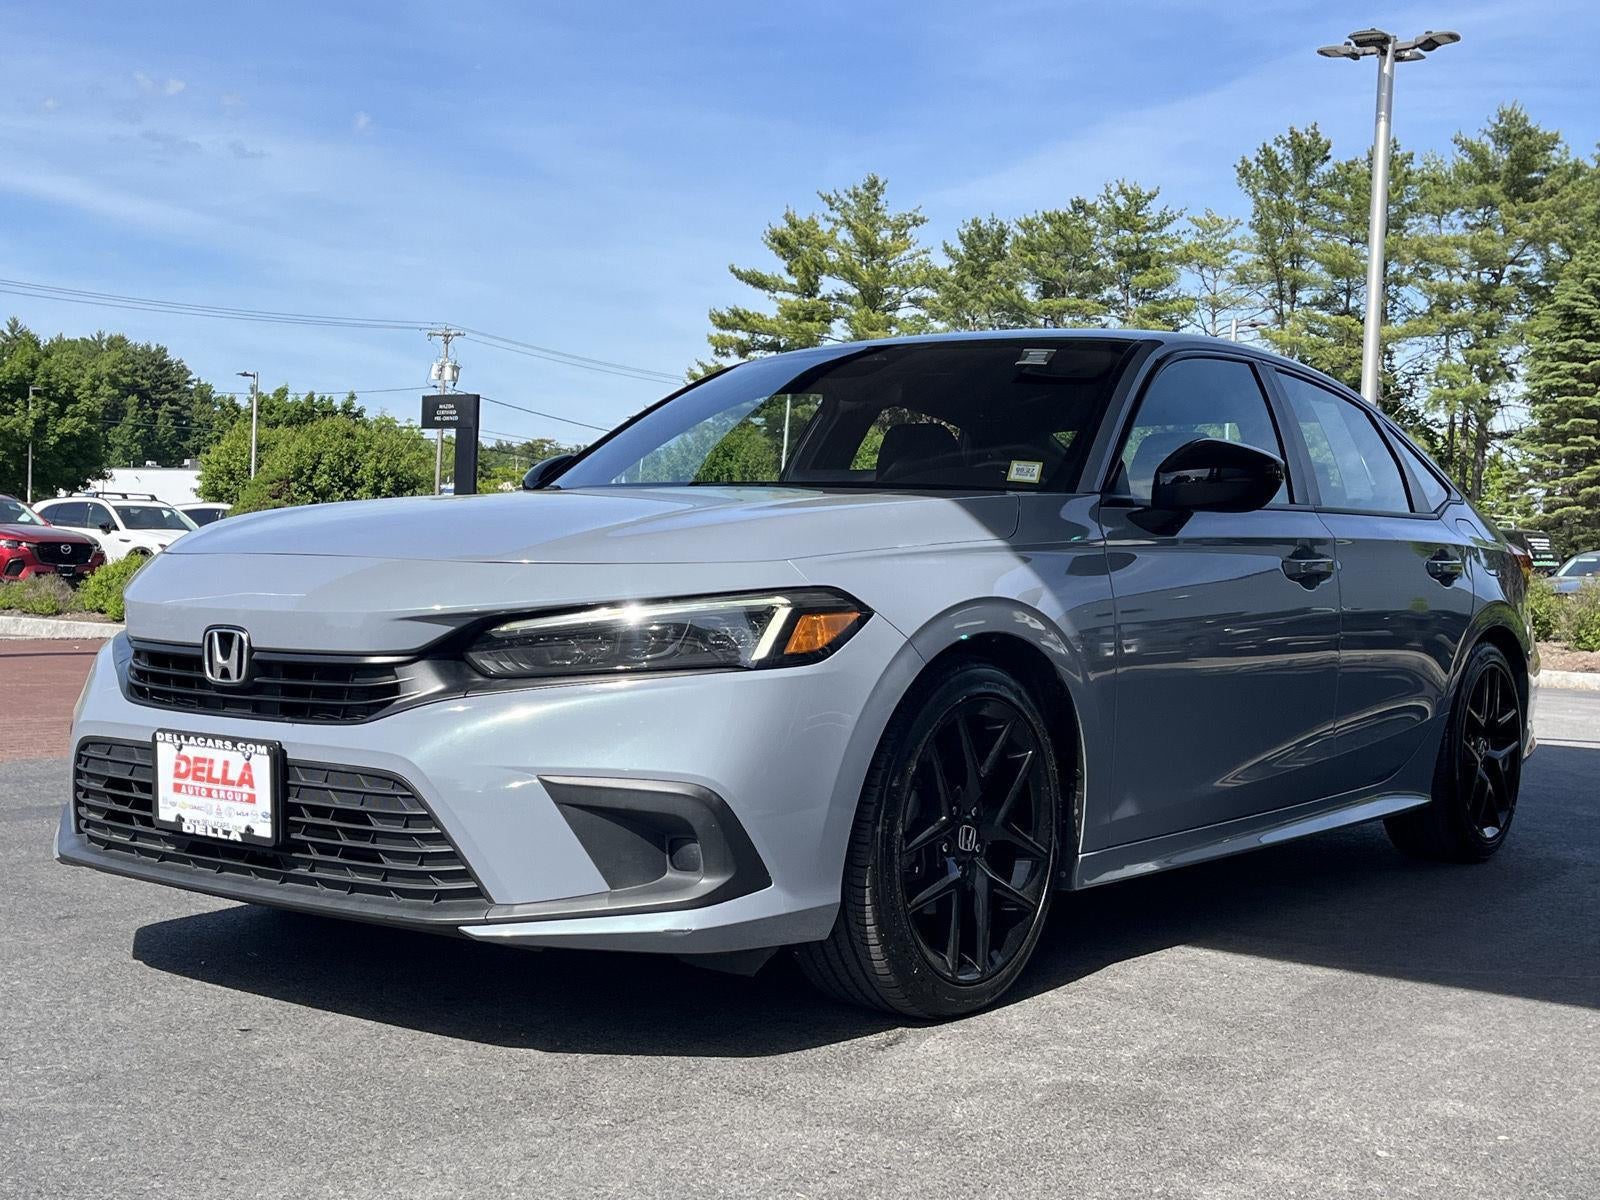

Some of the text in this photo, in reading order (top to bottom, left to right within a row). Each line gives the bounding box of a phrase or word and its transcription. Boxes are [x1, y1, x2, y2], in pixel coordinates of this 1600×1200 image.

[156, 732, 267, 755] DELLACARS.COM
[173, 754, 255, 789] DELLA
[180, 784, 249, 802] AUTO GROUP
[182, 823, 242, 842] DELLA
